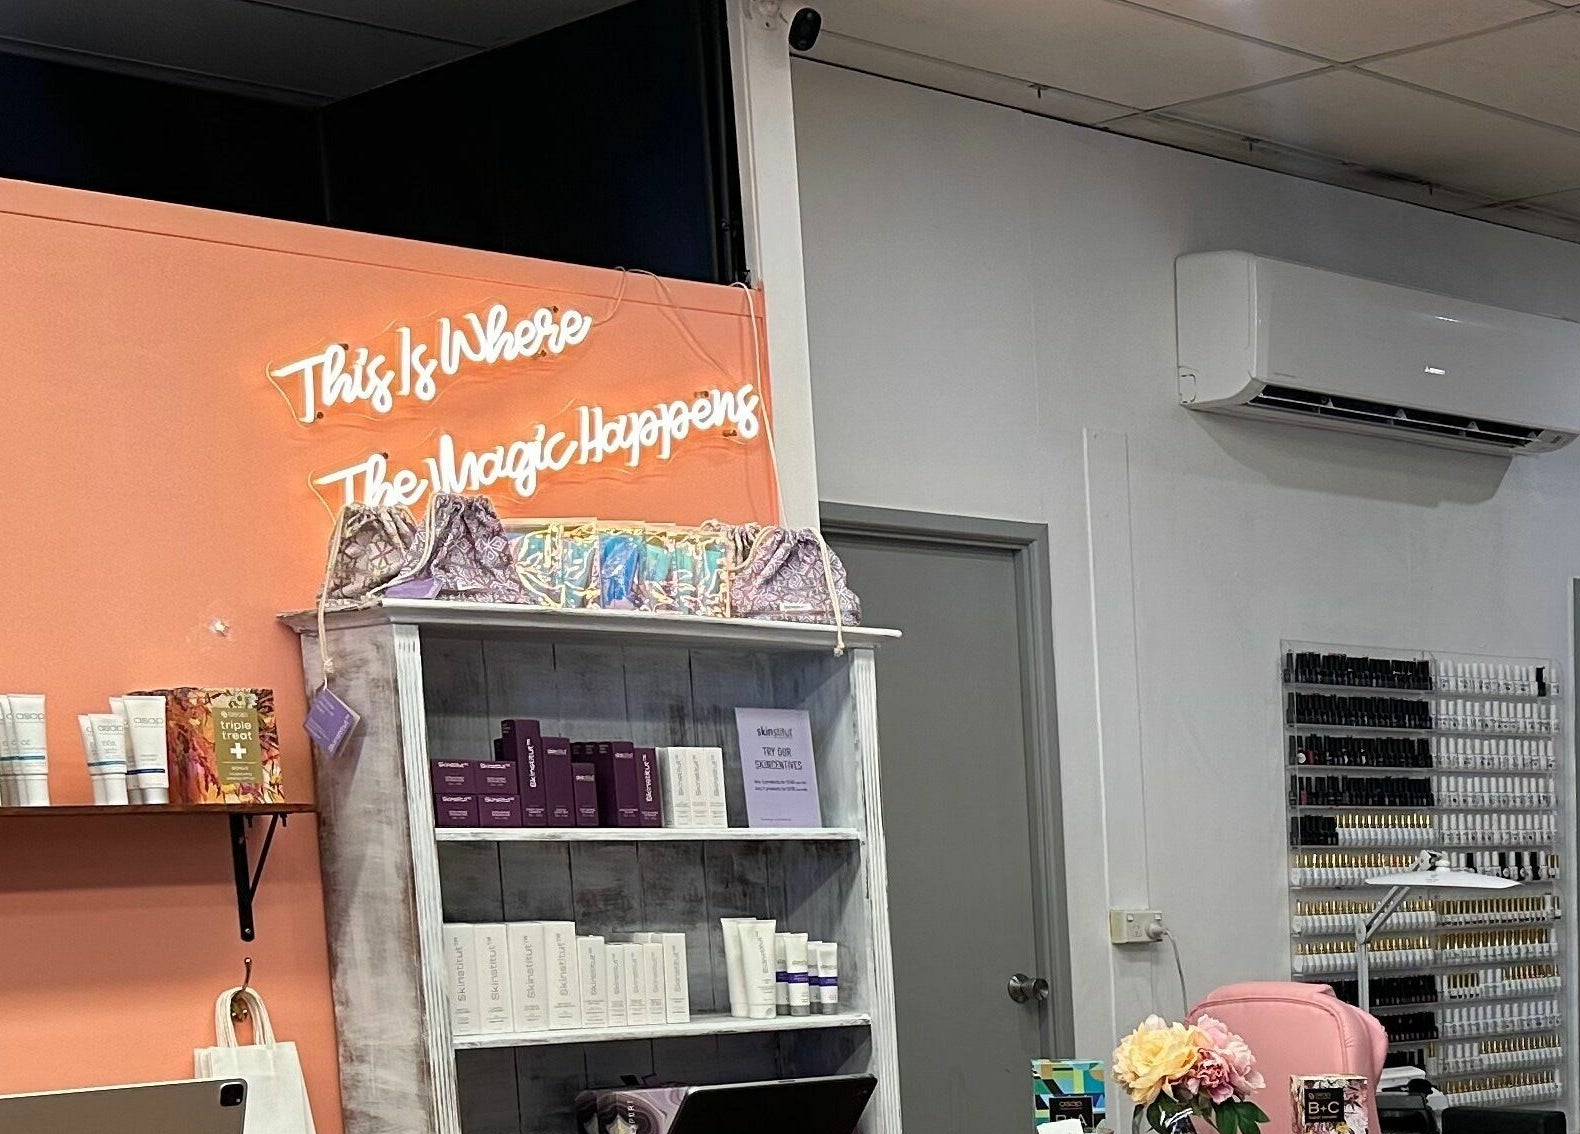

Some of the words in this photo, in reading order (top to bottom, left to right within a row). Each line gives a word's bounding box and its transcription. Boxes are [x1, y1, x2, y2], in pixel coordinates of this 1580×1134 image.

[270, 344, 395, 424] This
[398, 327, 436, 400] Is
[438, 304, 593, 374] Where
[314, 452, 429, 508] The
[429, 423, 581, 497] Magic
[575, 384, 760, 467] Happens
[220, 720, 252, 731] triple
[222, 731, 253, 740] treat
[762, 747, 775, 756] TRY
[777, 747, 792, 757] OUR
[1308, 1101, 1340, 1114] B+C
